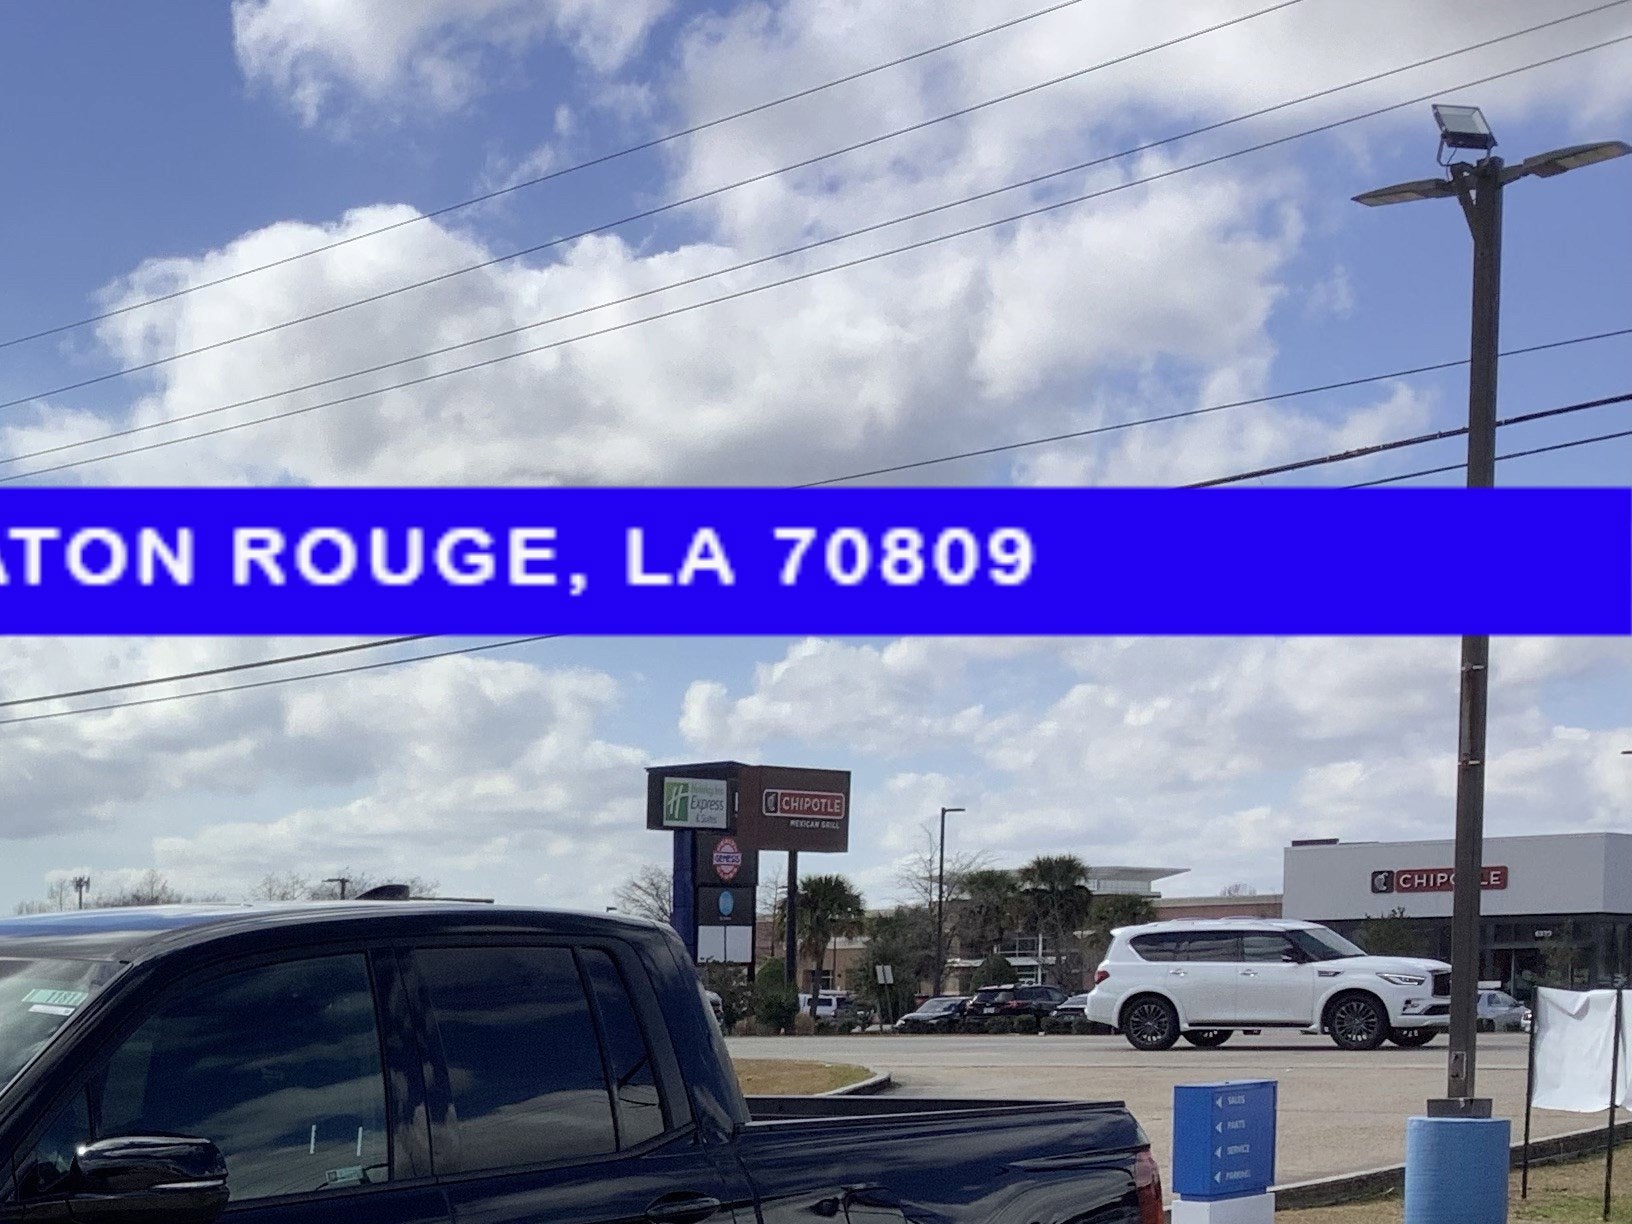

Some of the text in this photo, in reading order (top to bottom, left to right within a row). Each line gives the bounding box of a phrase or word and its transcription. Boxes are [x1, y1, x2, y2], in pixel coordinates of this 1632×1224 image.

[690, 795, 725, 813] Express
[781, 796, 842, 813] CHIPOTLE
[790, 819, 820, 829] MEXICAN
[1399, 870, 1502, 889] CHIPE
